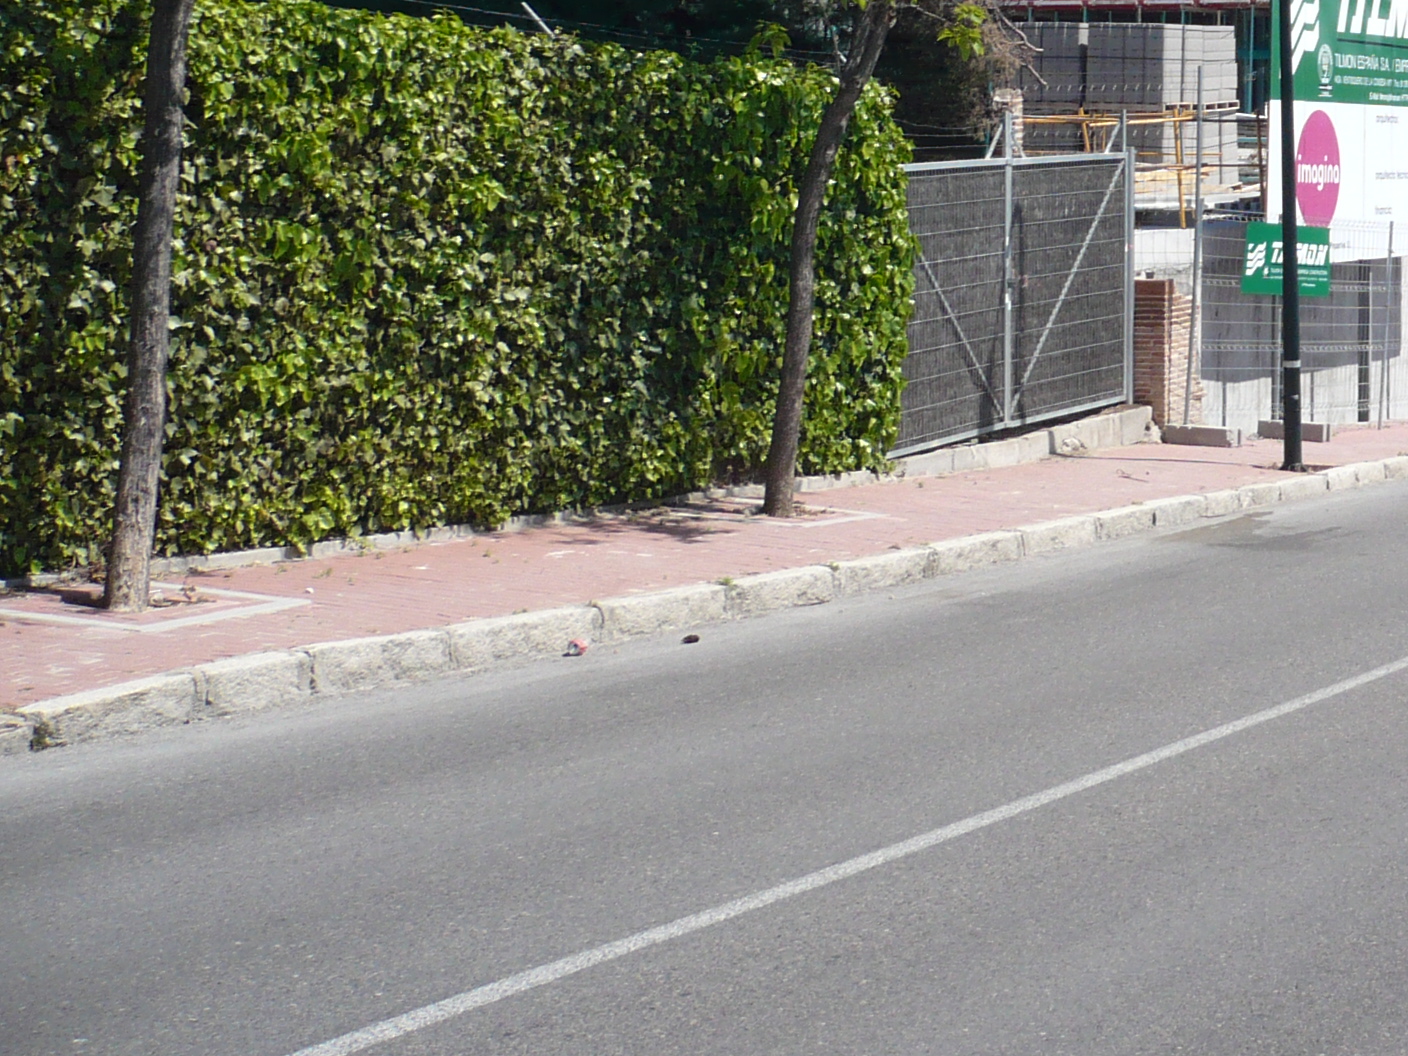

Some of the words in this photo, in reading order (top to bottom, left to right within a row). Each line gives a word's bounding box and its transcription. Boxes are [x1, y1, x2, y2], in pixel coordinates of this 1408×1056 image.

[1357, 54, 1378, 71] ESPAÑA
[1298, 155, 1341, 191] imagina
[1271, 241, 1329, 266] TMON
